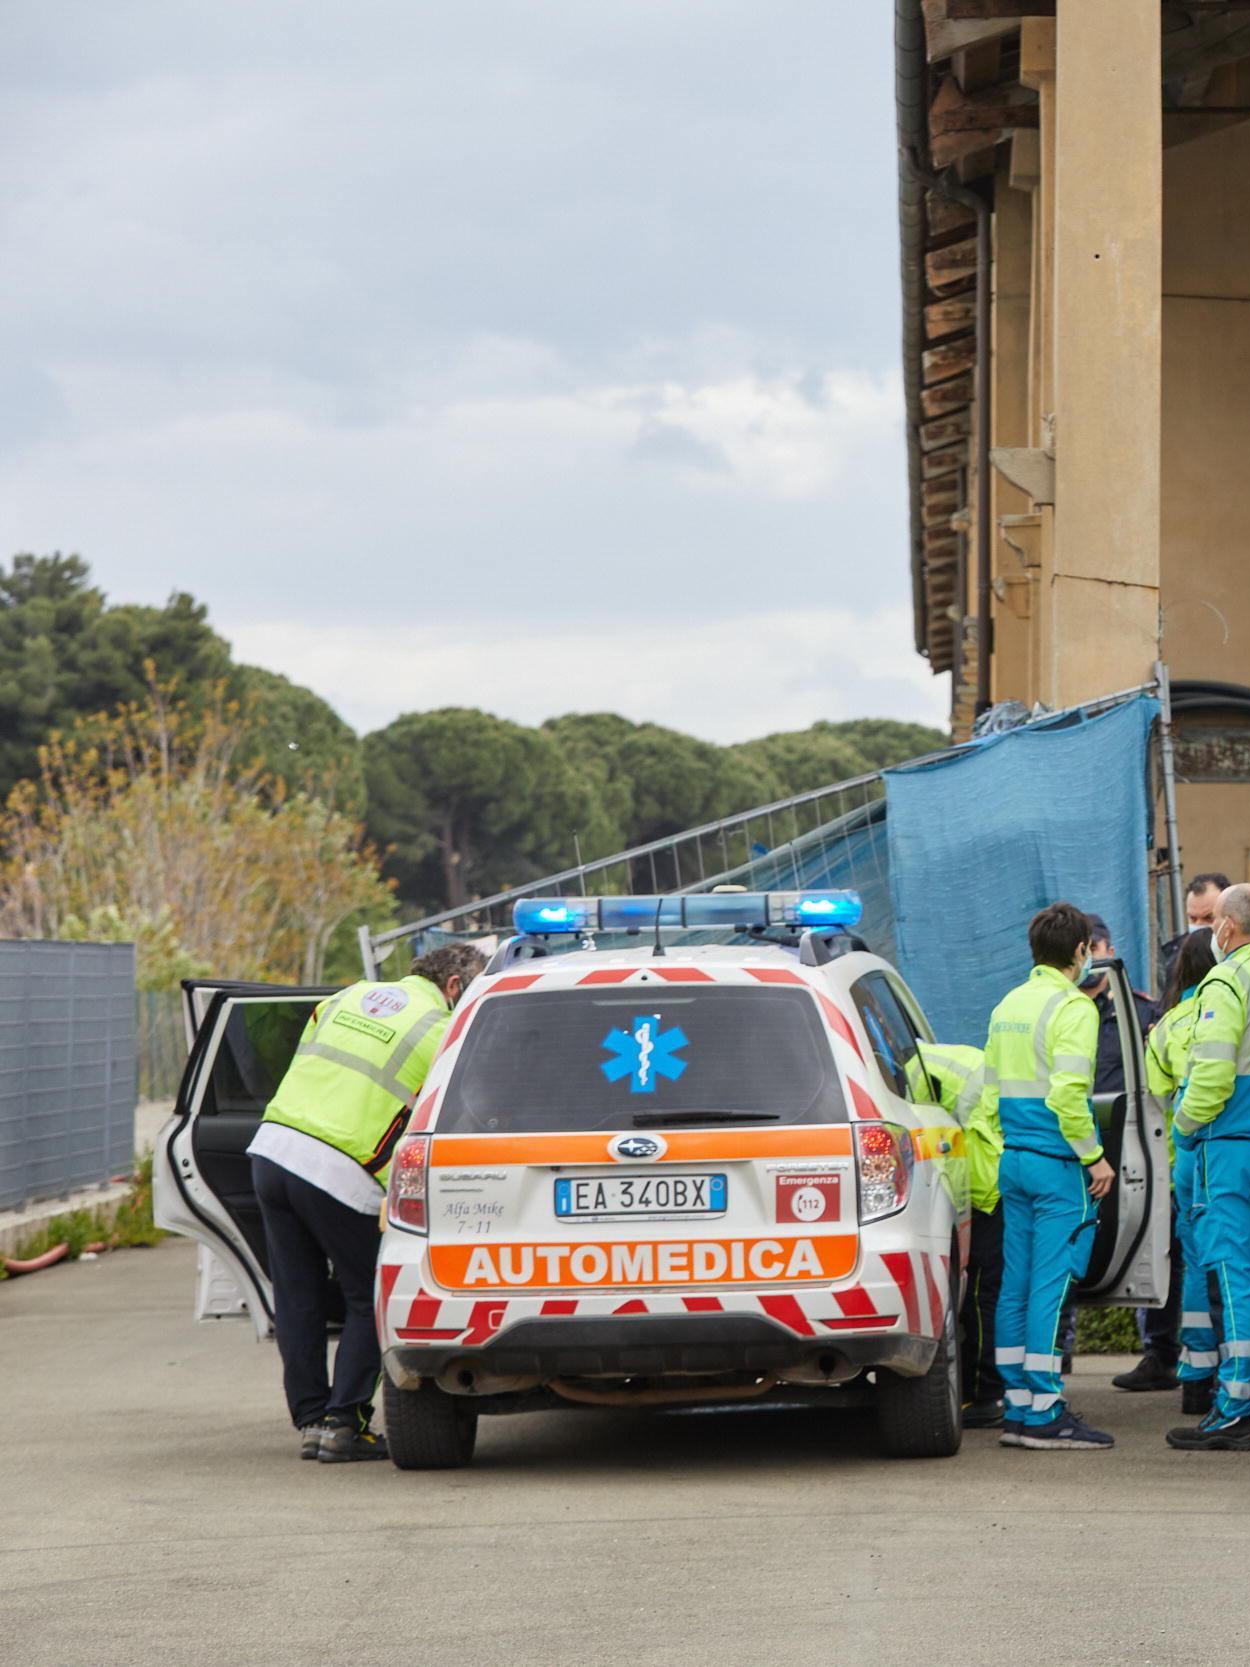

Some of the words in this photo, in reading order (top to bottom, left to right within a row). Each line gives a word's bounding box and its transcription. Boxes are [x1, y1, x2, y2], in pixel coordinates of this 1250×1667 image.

[779, 1176, 839, 1186] Emergenza
[576, 1182, 608, 1210] EA
[620, 1179, 706, 1208] 340BX
[443, 1202, 470, 1219] Alfa
[474, 1201, 505, 1217] Mike
[803, 1200, 820, 1209] 112
[463, 1239, 825, 1285] AUTOMEDICA
